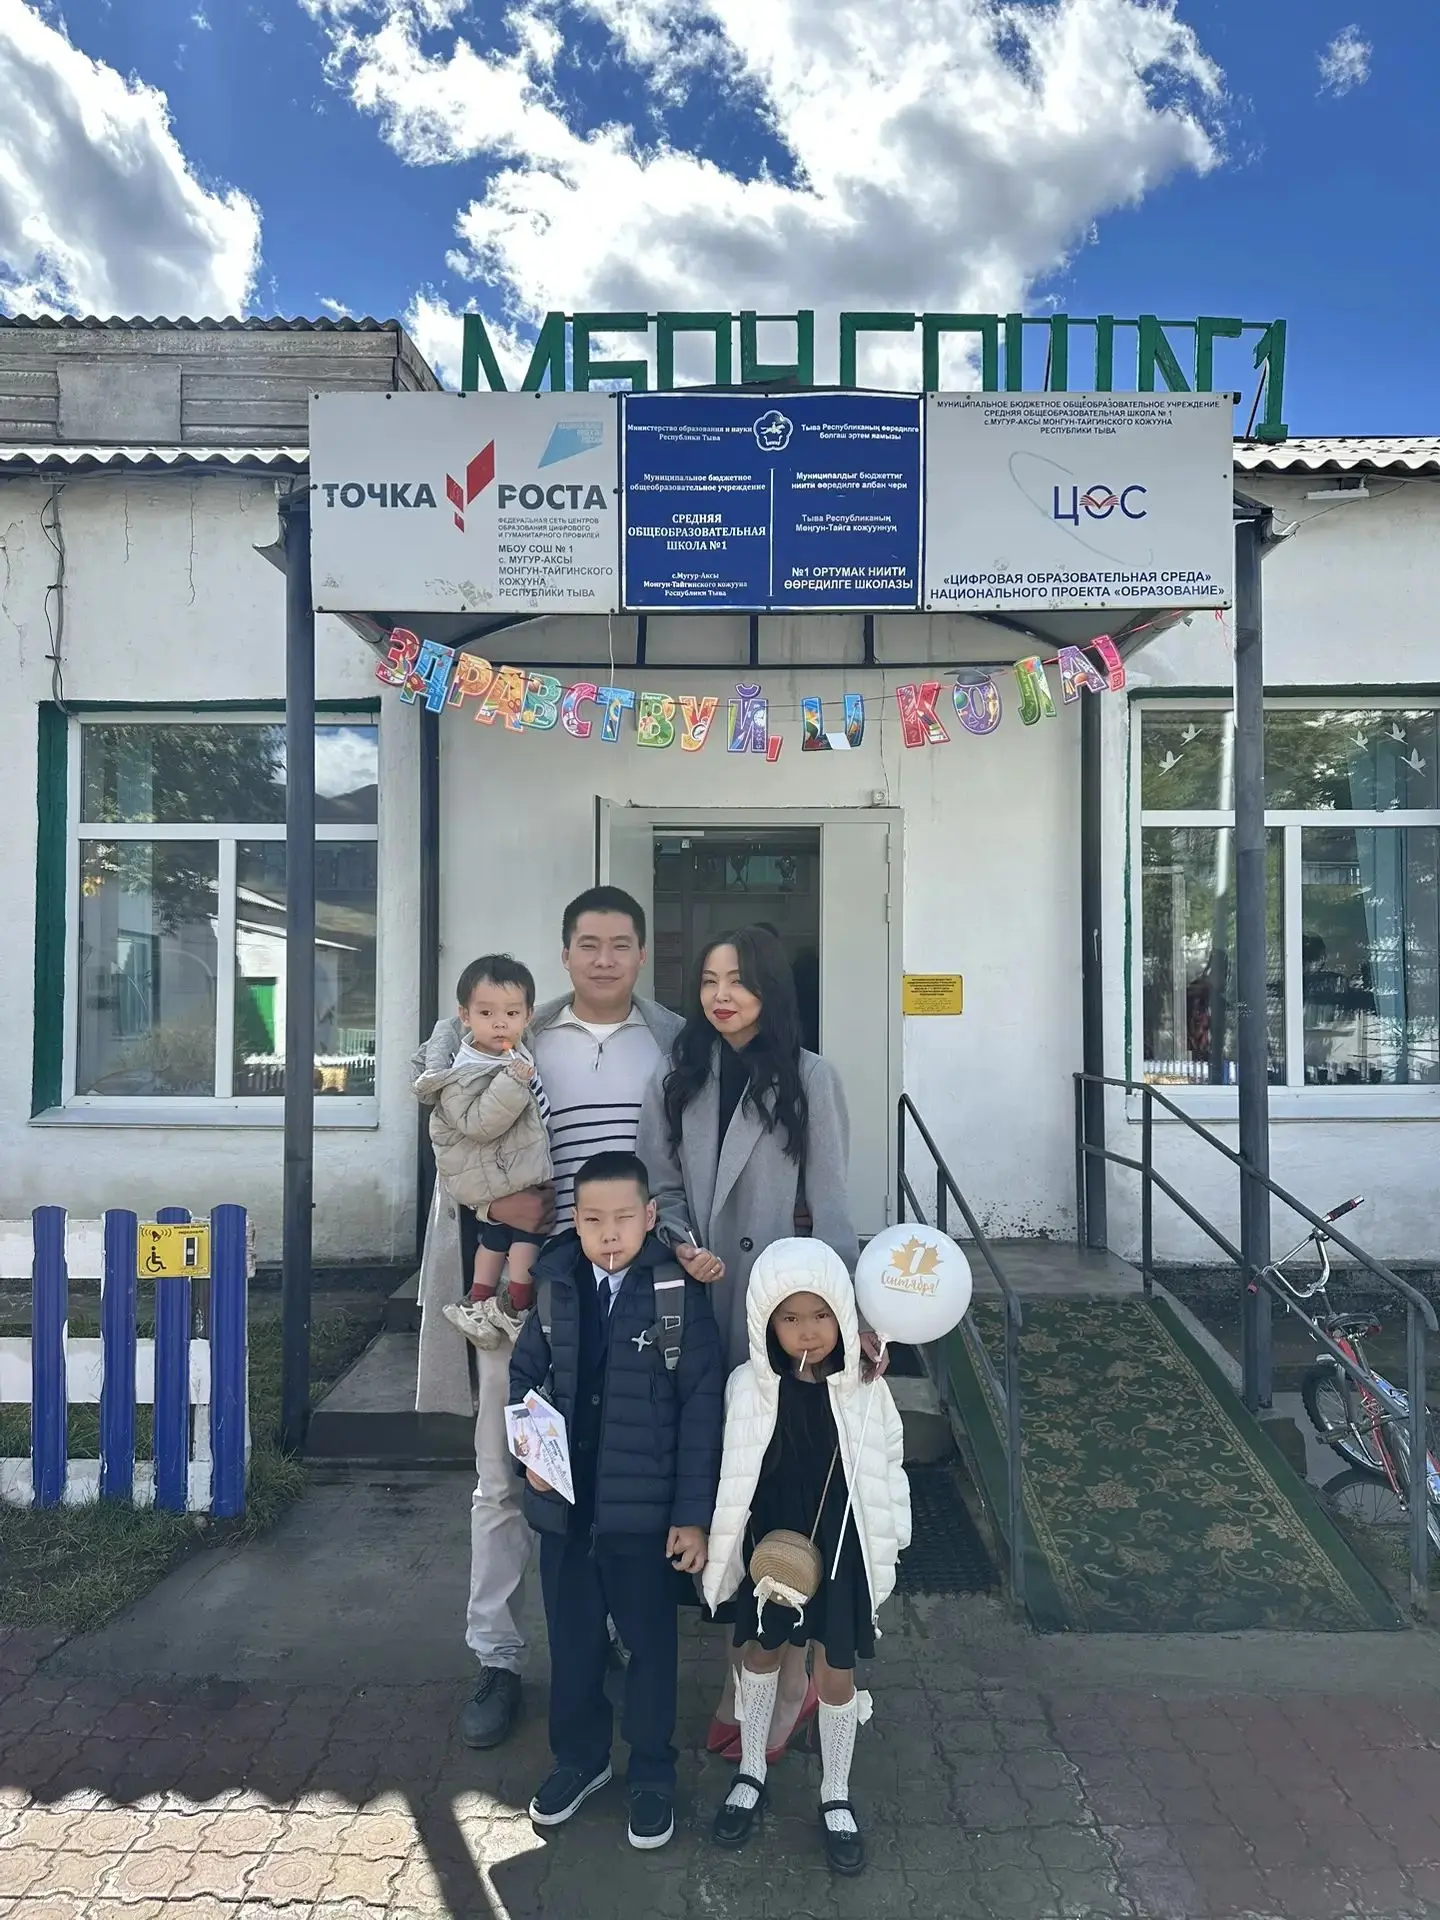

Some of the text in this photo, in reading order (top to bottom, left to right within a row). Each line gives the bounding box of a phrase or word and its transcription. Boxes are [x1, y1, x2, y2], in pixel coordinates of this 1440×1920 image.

[937, 401, 1220, 409] МУНИЦИПАЛЬНОЕ БЮДЖЕТНОЕ ОБЩЕОБРАЗОВАТЕЛЬНОЕ УЧРЕЖДЕНИЕ
[984, 409, 1021, 417] СРЕДНЯЯ
[1023, 410, 1125, 418] ОБЩЕОБРАЗОВАТЕЛЬНАЯ
[1042, 418, 1133, 426] МОНГУН-ТАЙГИНСКОГО
[1134, 418, 1173, 426] КОЖУУНА
[627, 424, 678, 434] Министерство
[679, 424, 724, 434] образования
[731, 426, 753, 434] науки
[800, 423, 821, 432] Тыва
[1040, 427, 1117, 435] РЕСПУБЛИКИ ТЫВА
[659, 433, 701, 442] Республики
[819, 431, 847, 439] болгаш
[848, 432, 870, 441] эртем
[643, 473, 752, 483] Муниципальное бюджетное
[796, 471, 904, 481] Муниципалдыг бюджеттиг
[630, 483, 766, 492] общеобразовательное учреждение
[791, 482, 816, 490] ниити
[861, 481, 887, 490] албан
[888, 482, 908, 491] чери
[322, 483, 607, 510] ТОЧКА РОСТА
[671, 513, 722, 525] СРЕДНЯЯ
[802, 513, 891, 523] Тыва Республиканың
[627, 526, 766, 539] ОБЩЕОБРАЗОВАТЕЛЬНАЯ
[498, 545, 526, 553] МБОУ
[529, 545, 552, 553] СОШ
[568, 545, 573, 553] 1
[666, 540, 708, 551] ШКОЛА
[509, 556, 573, 564] МУГУР-АКСЫ
[498, 565, 613, 575] МОНГУН-ТАЙГИНСКОГО
[812, 567, 865, 577] ОРТУМАК
[868, 566, 907, 576] НИИТИ
[498, 578, 547, 586] КОЖУУНА
[943, 571, 1212, 586] «ЦИФРОВАЯ ОБРАЗОВАТЕЛЬНАЯ СРЕДА»
[643, 580, 748, 590] Монгун-Тайгинского кожууна
[784, 579, 914, 591] ӨӨРЕДИЛГЕ ШКОЛАЗЫ
[499, 588, 595, 597] РЕСПУБЛИКИ ТЫВА
[664, 589, 727, 598] Республики Тыва
[930, 585, 1224, 600] НАЦИОНАЛЬНОГО ПРОЕКТА «ОБРАЗОВАНИЕ»
[375, 627, 784, 763] ЗДРАВСТВУЙ,
[910, 1246, 926, 1273] 1
